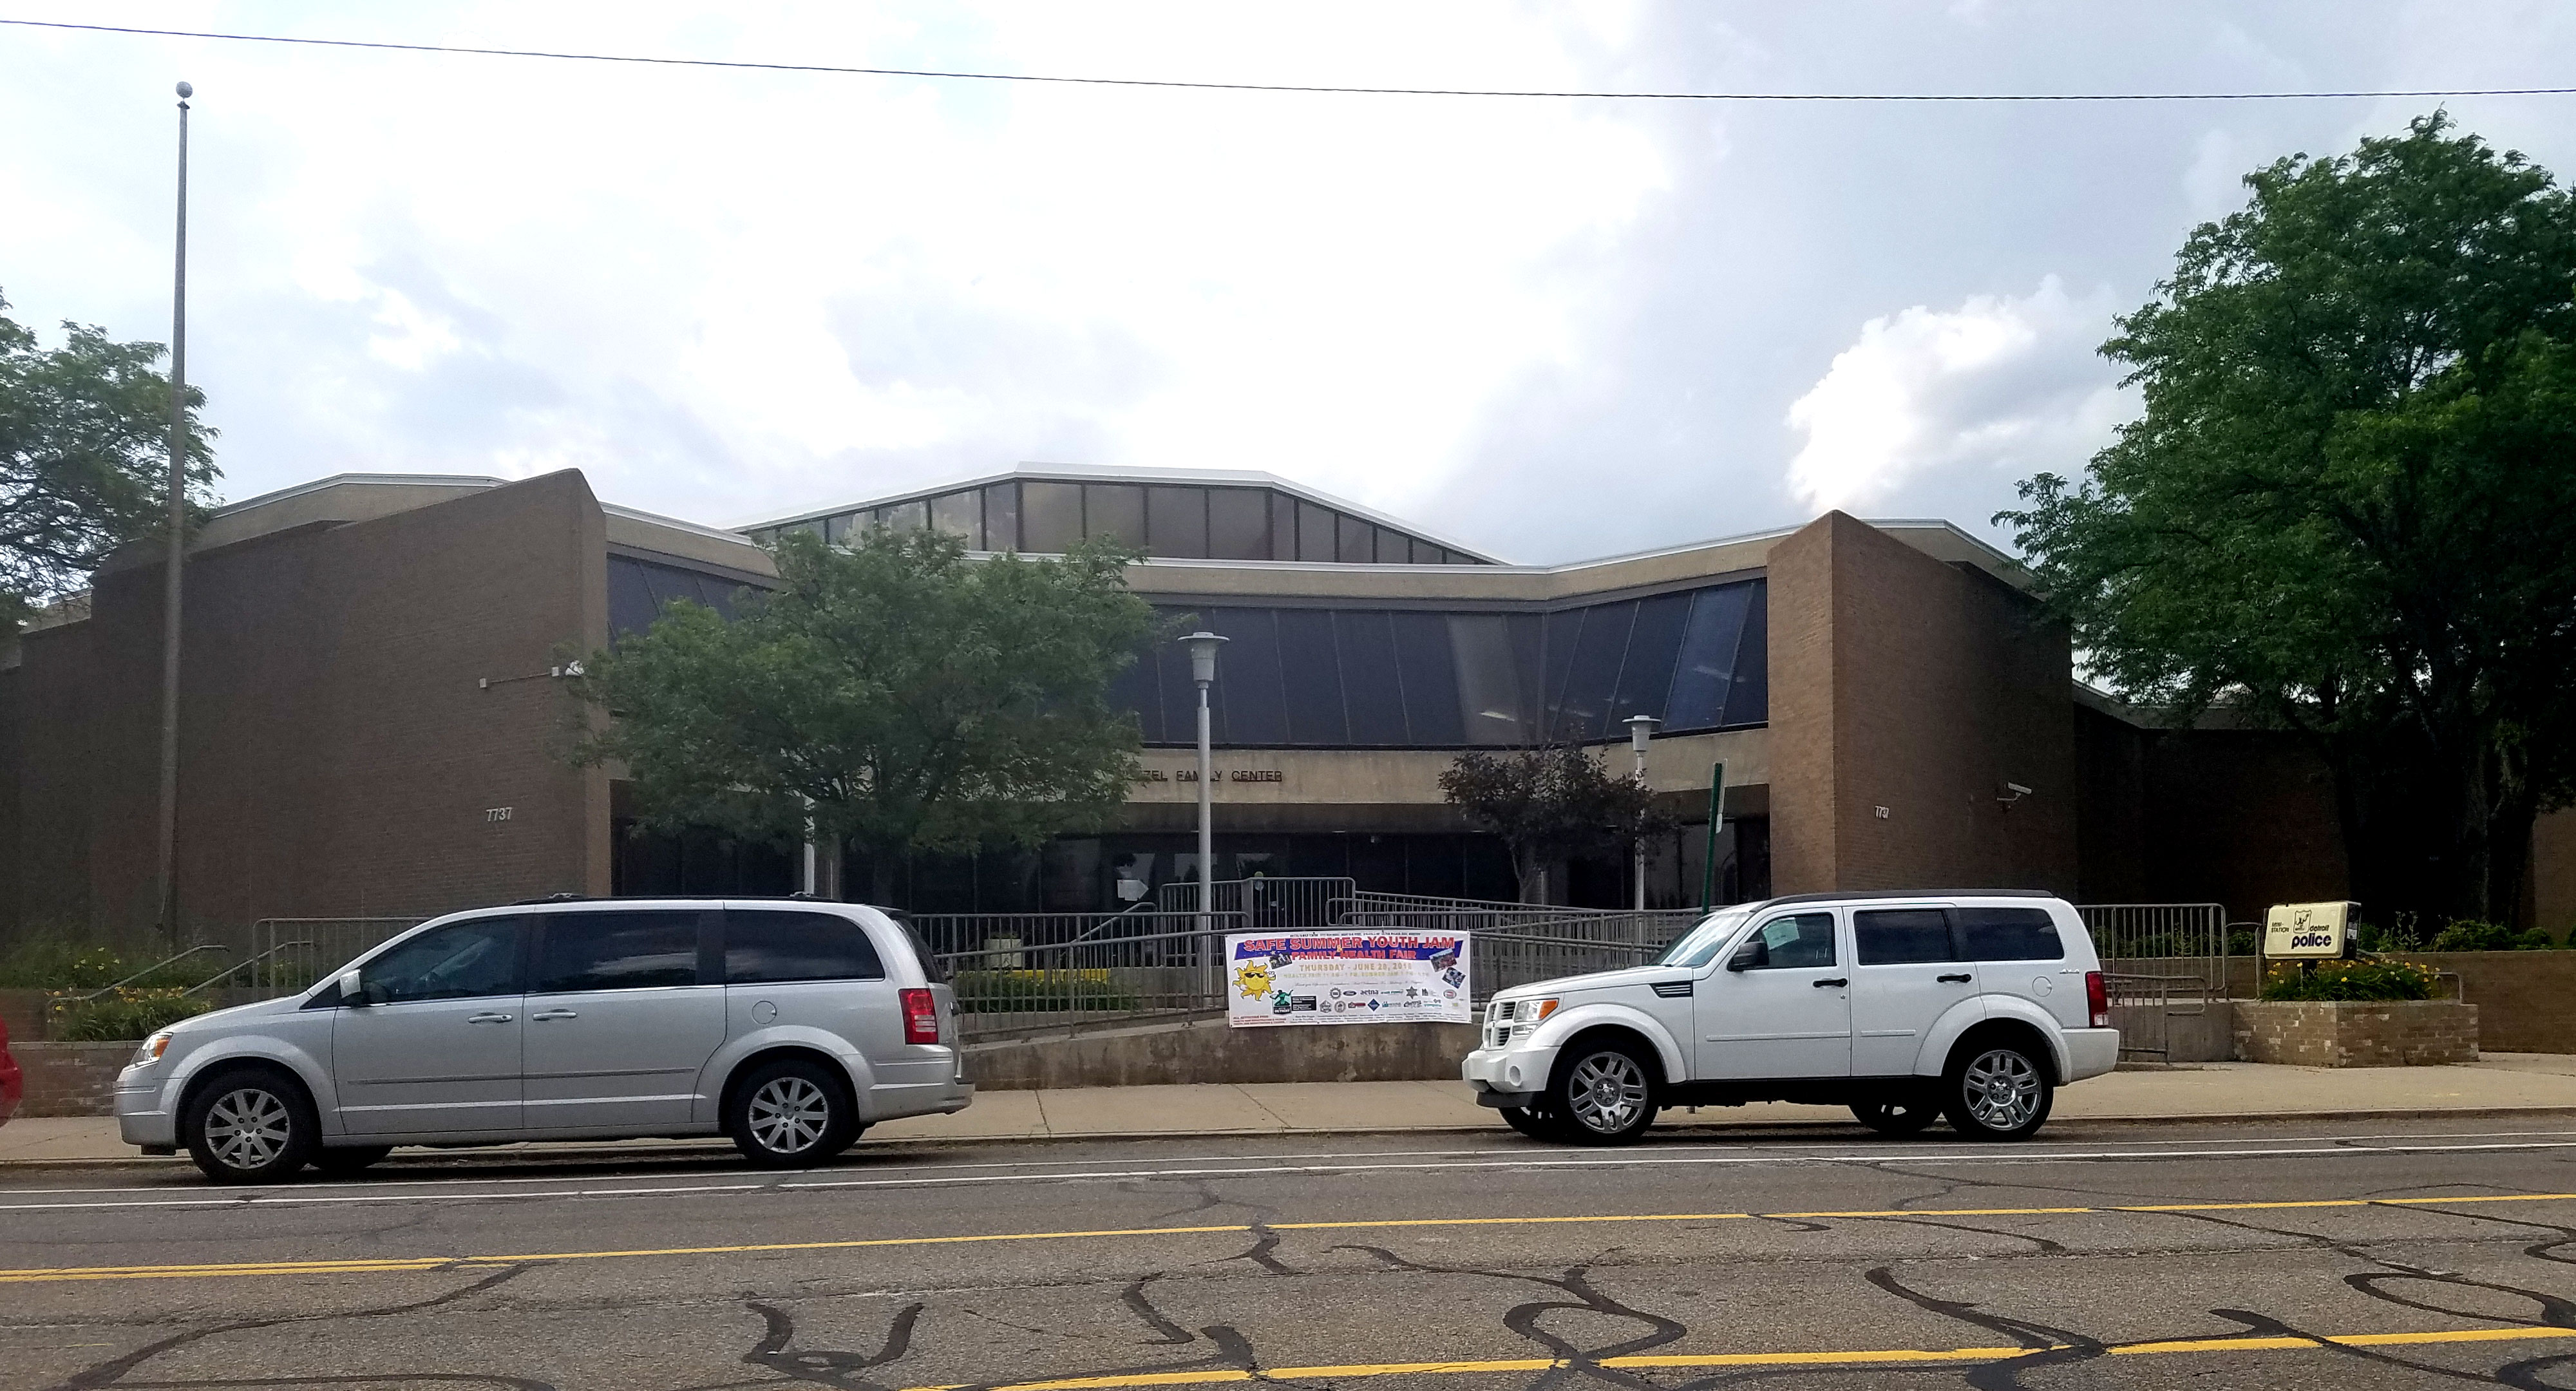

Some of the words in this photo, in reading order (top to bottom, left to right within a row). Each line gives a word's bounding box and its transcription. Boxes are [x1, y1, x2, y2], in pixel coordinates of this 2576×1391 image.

[1231, 770, 1282, 782] CENTER
[486, 807, 513, 821] 7737
[1244, 938, 1287, 951] SAFE
[1289, 937, 1363, 950] SUMMER
[1367, 936, 1419, 949] YOUTH
[1422, 937, 1455, 949] JAM
[2291, 932, 2332, 950] police
[1291, 951, 1336, 960] FAMILY
[1340, 950, 1385, 959] HEALTH
[1388, 950, 1417, 960] FAIR
